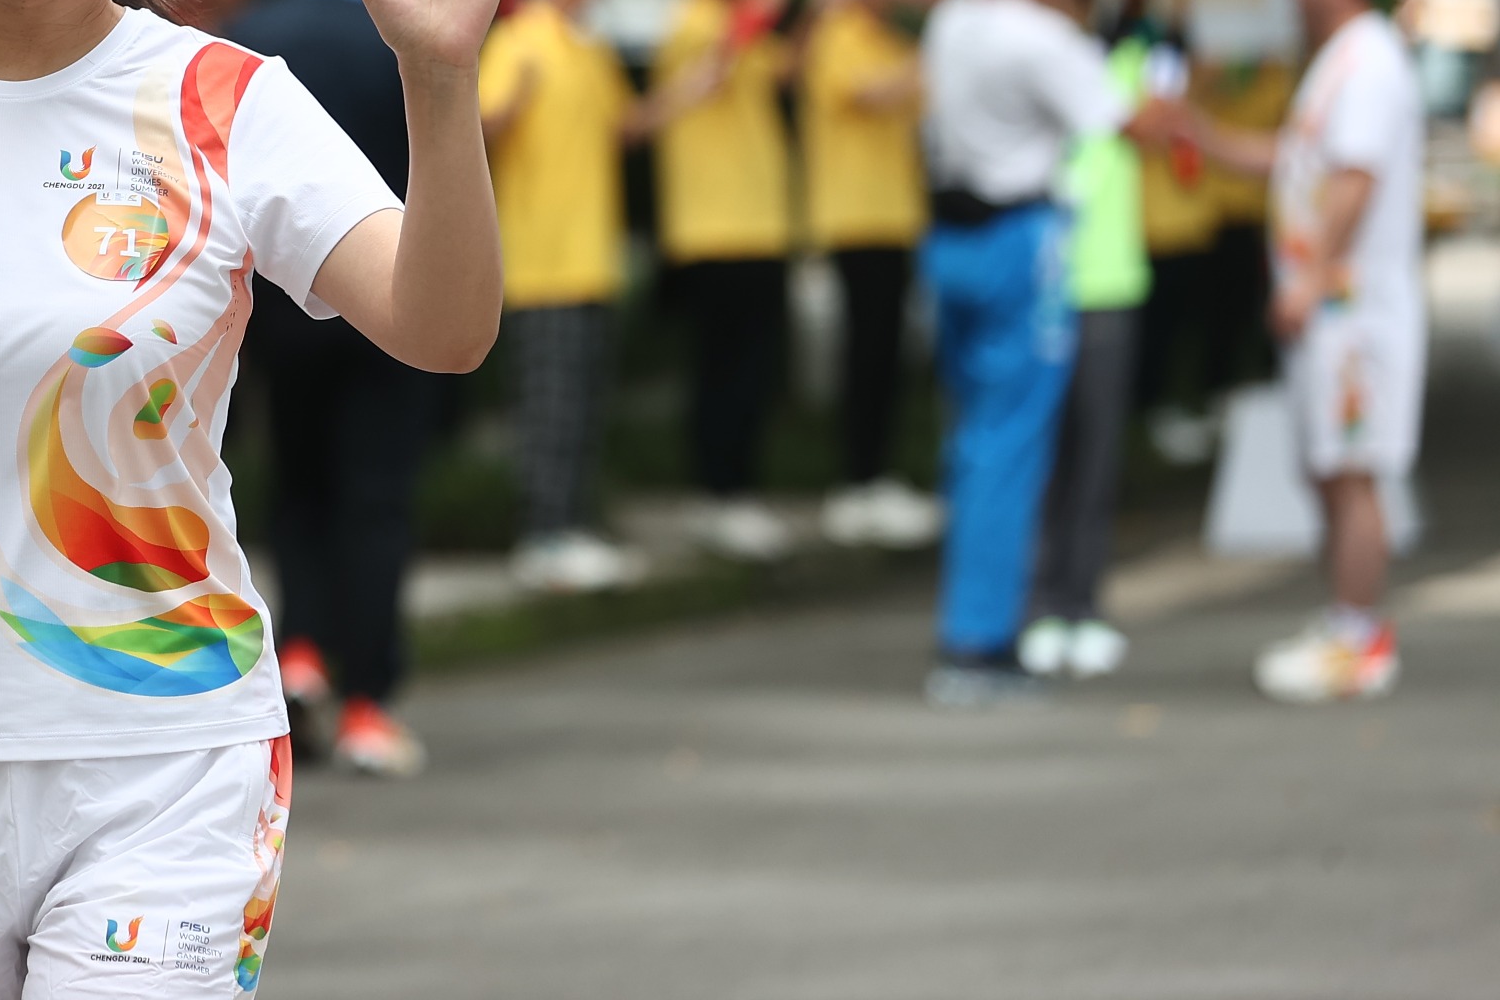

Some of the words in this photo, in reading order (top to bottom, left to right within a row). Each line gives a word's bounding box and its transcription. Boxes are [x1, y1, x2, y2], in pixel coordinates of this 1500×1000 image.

[131, 150, 164, 164] FISU
[131, 158, 164, 171] WORLD
[130, 177, 162, 187] GAMES
[131, 167, 180, 184] UNIVERSITY
[42, 181, 85, 190] CHENGDU
[130, 183, 169, 197] SUMMER
[93, 226, 141, 258] 71
[180, 921, 211, 934] FISU
[179, 932, 211, 945] WORLD
[178, 941, 223, 958] UNIVERSITY
[90, 953, 131, 963] CHENGDU
[132, 956, 150, 964] 2021
[176, 951, 206, 964] GAMES
[174, 960, 211, 975] SUMMER
